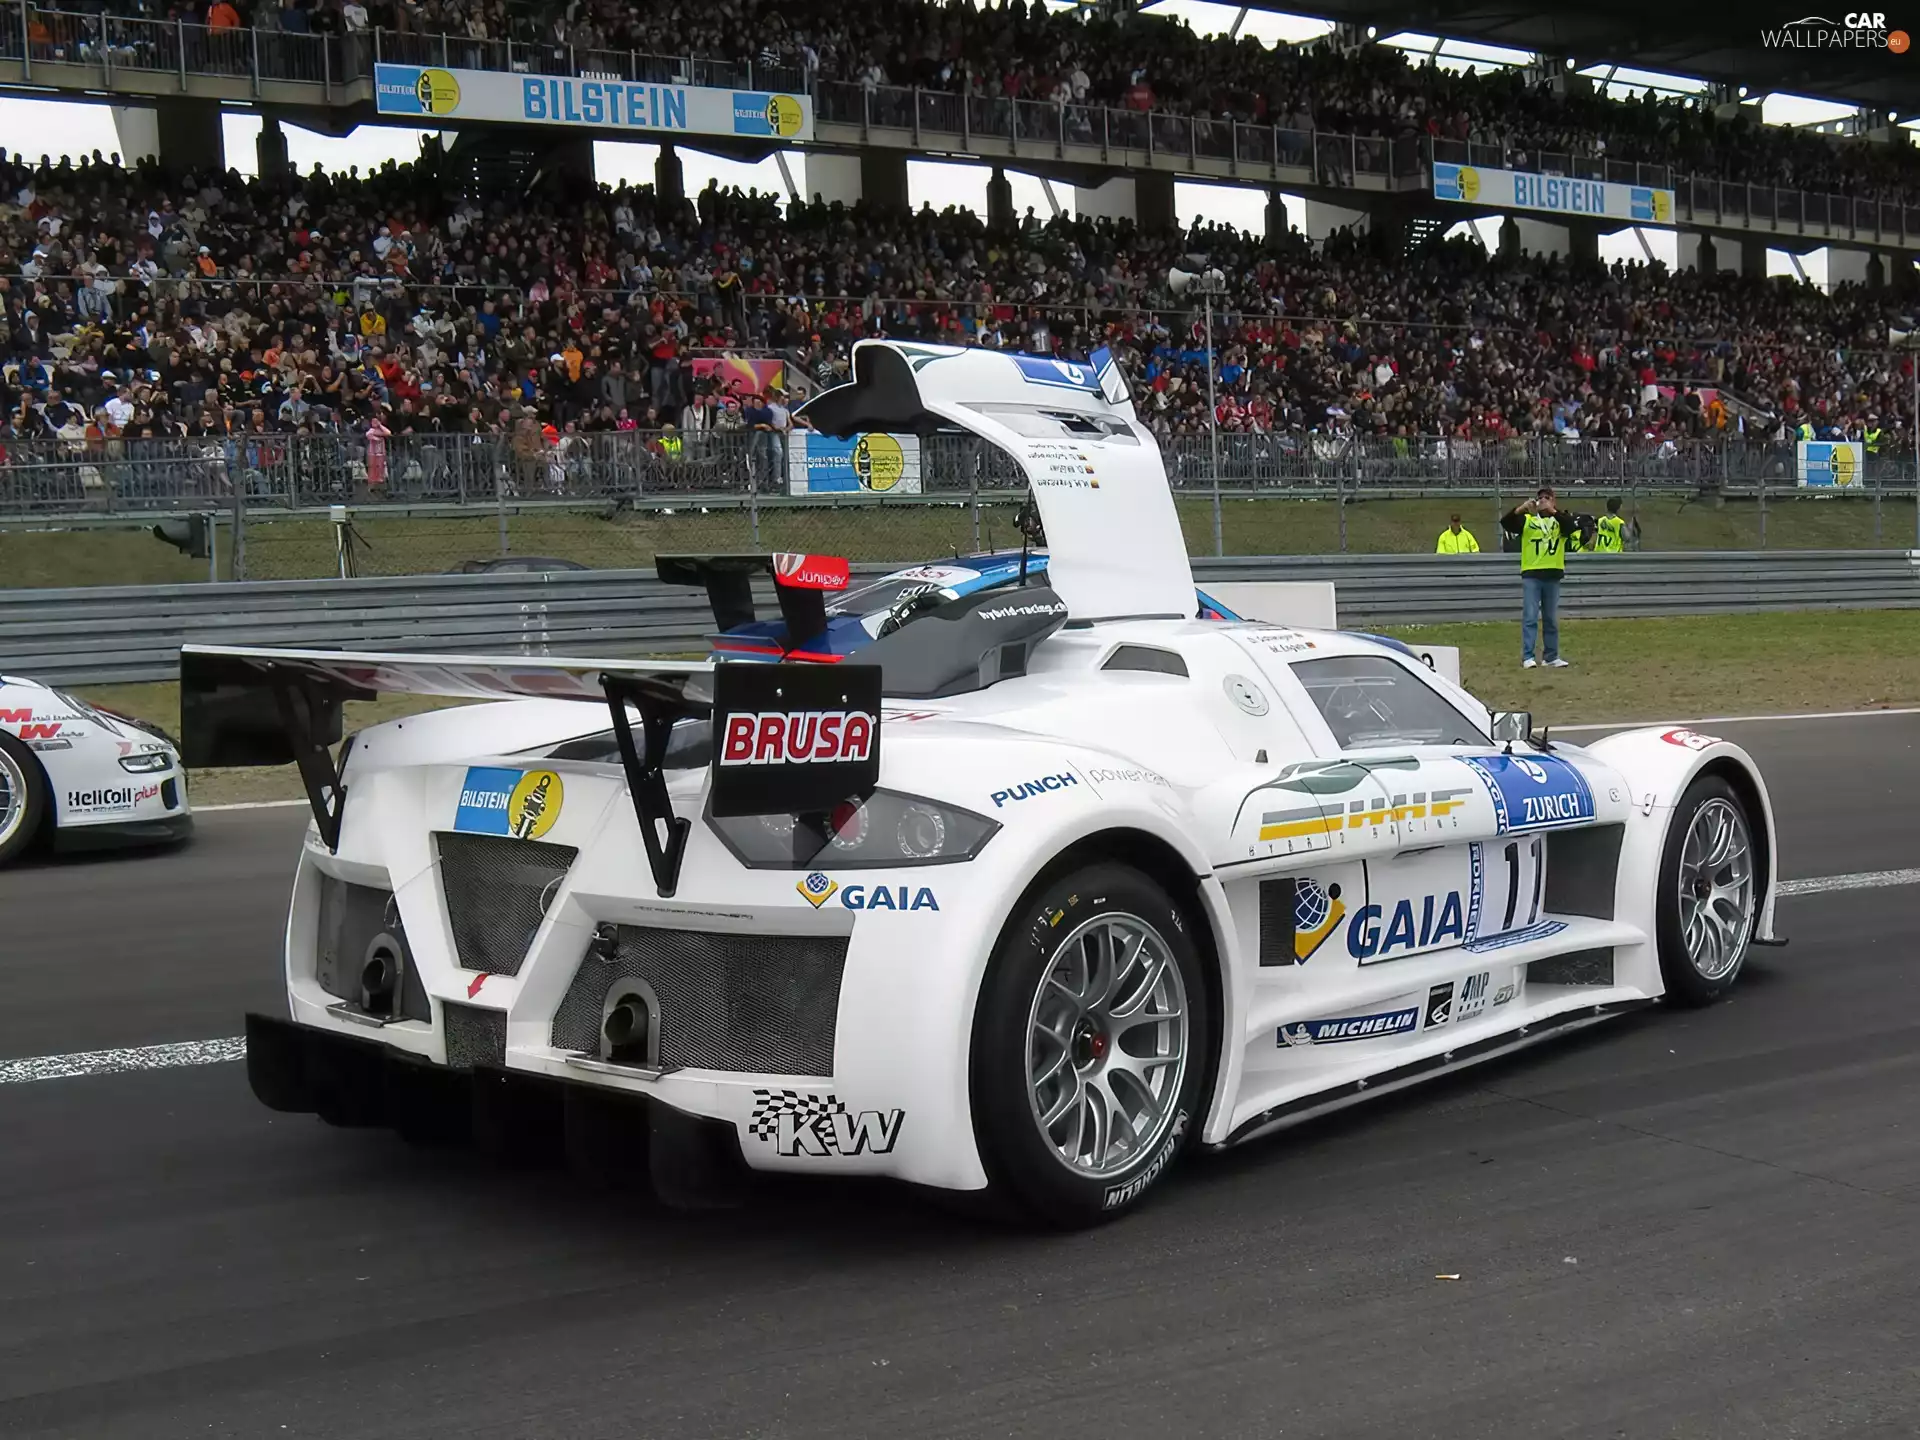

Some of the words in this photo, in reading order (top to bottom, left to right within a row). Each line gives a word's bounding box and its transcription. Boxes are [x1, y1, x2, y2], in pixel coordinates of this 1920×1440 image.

[523, 78, 687, 128] BILSTEIN
[1514, 175, 1605, 214] BILSTEIN
[1530, 538, 1559, 555] TV
[720, 711, 873, 766] BRUSA
[460, 790, 510, 810] BILSTEIN
[991, 772, 1077, 807] PUNCH
[1523, 793, 1580, 823] ZURICH
[841, 886, 939, 911] GAIA
[1502, 838, 1543, 931] 11
[1347, 891, 1463, 959] GAIA
[1317, 1013, 1414, 1039] MICHELIN
[776, 1108, 906, 1157] KW
